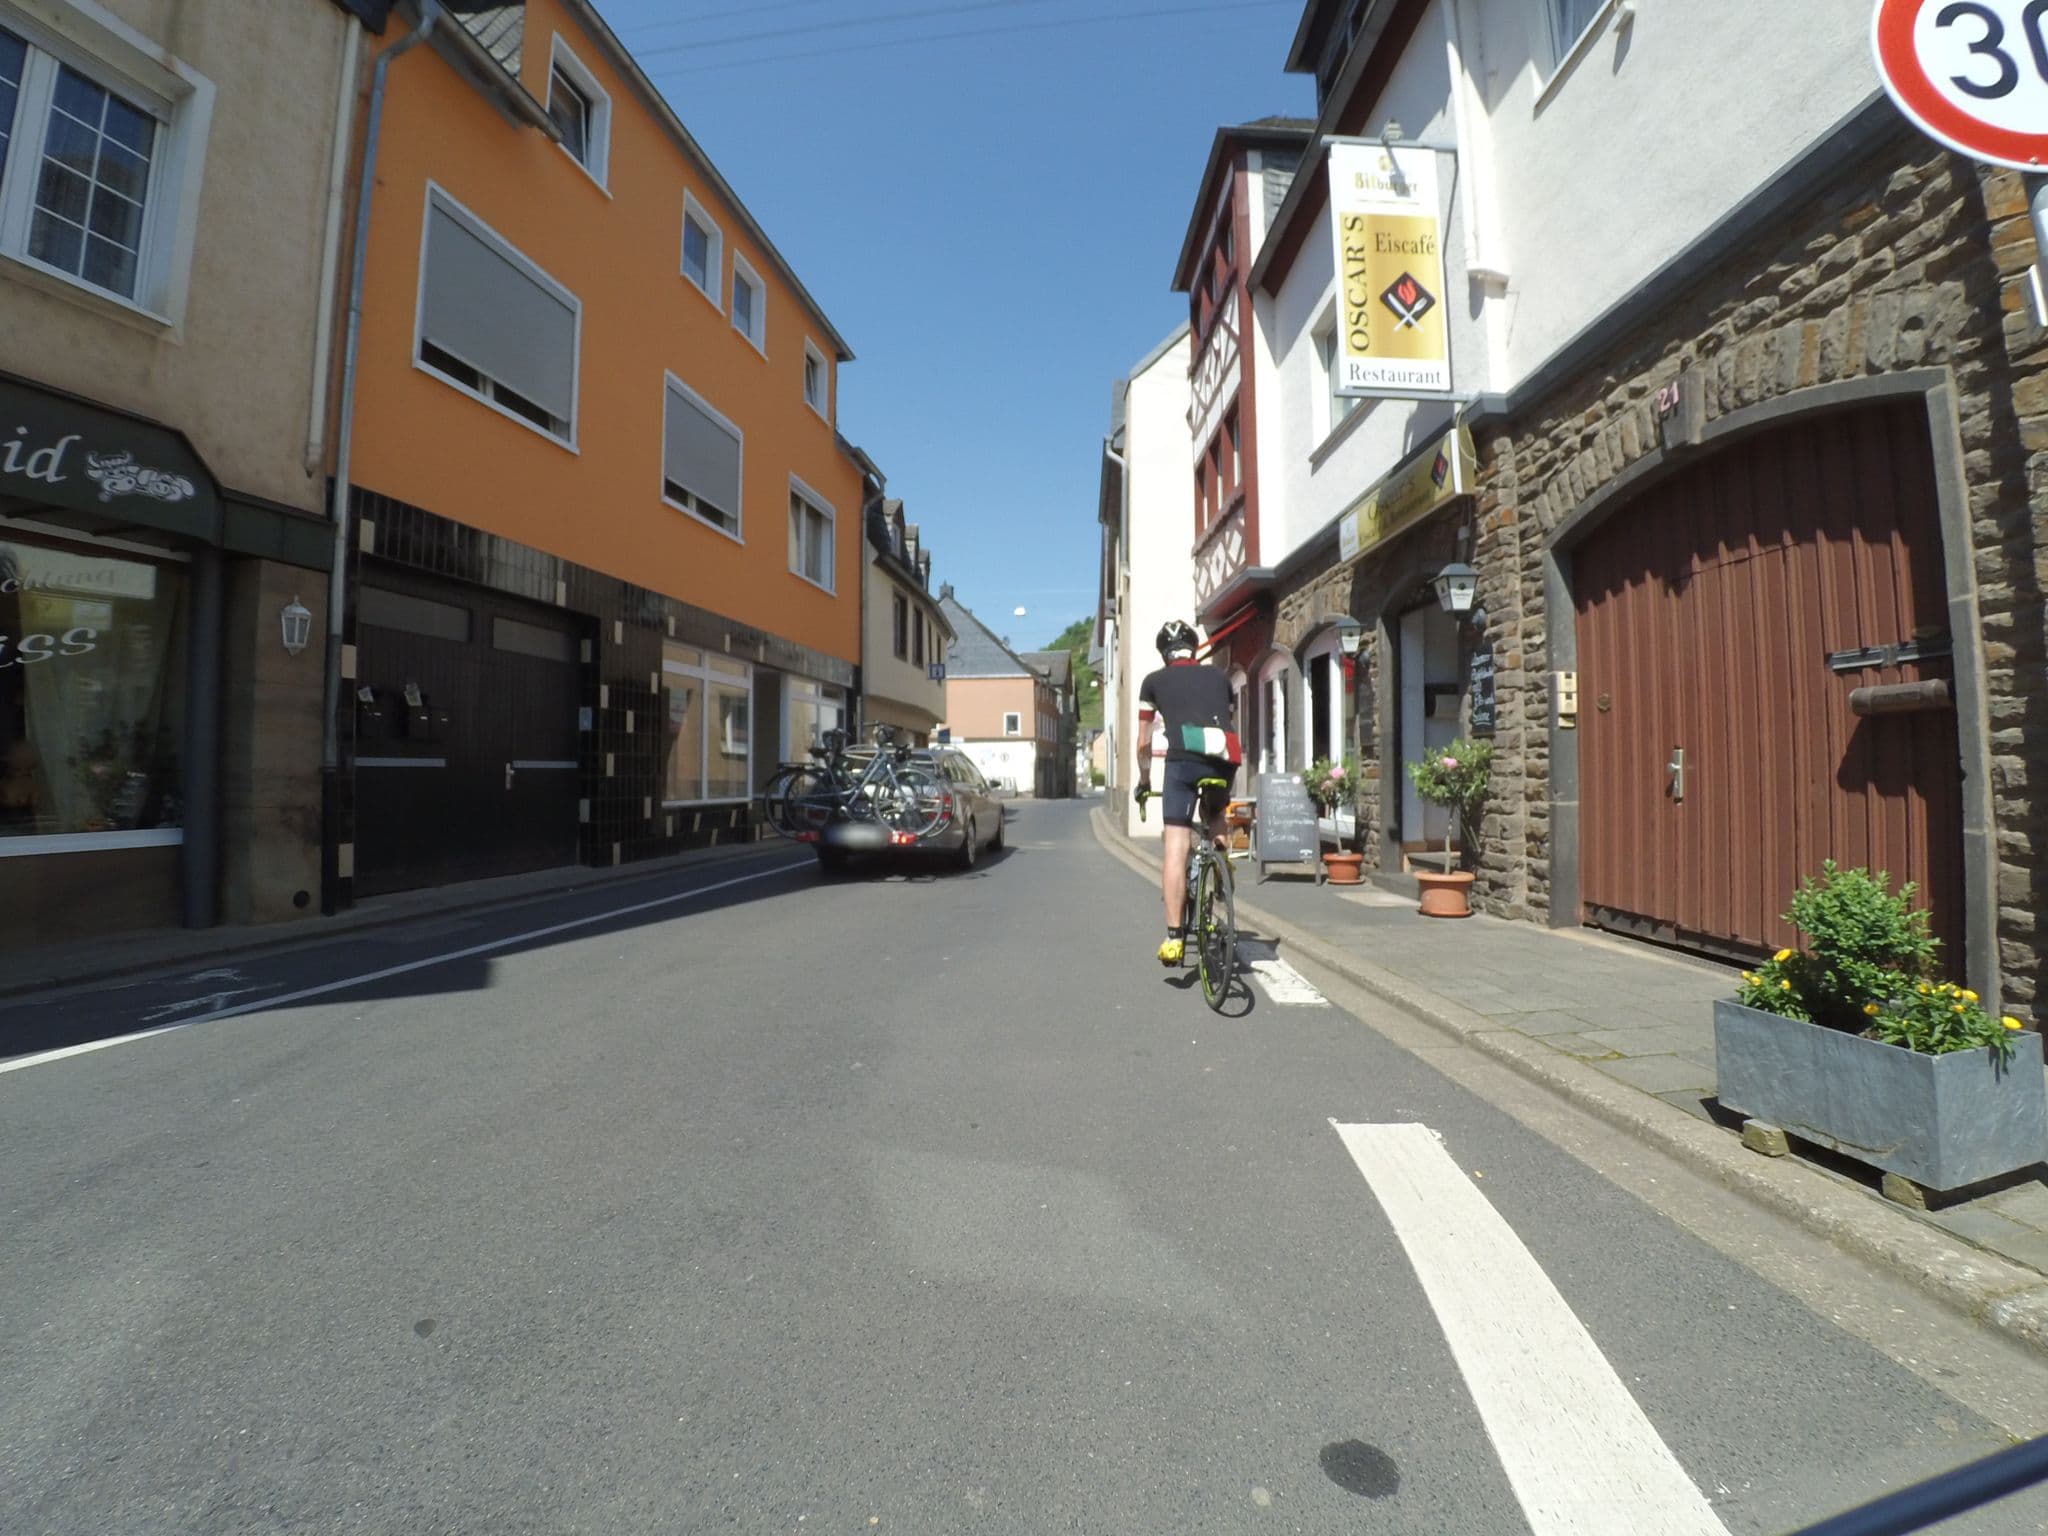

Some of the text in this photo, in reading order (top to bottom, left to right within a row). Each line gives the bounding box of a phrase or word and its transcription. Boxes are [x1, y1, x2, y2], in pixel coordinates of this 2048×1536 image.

[1375, 232, 1435, 255] Eiscafé
[1349, 363, 1441, 385] Restaurant
[1656, 381, 1680, 413] 21
